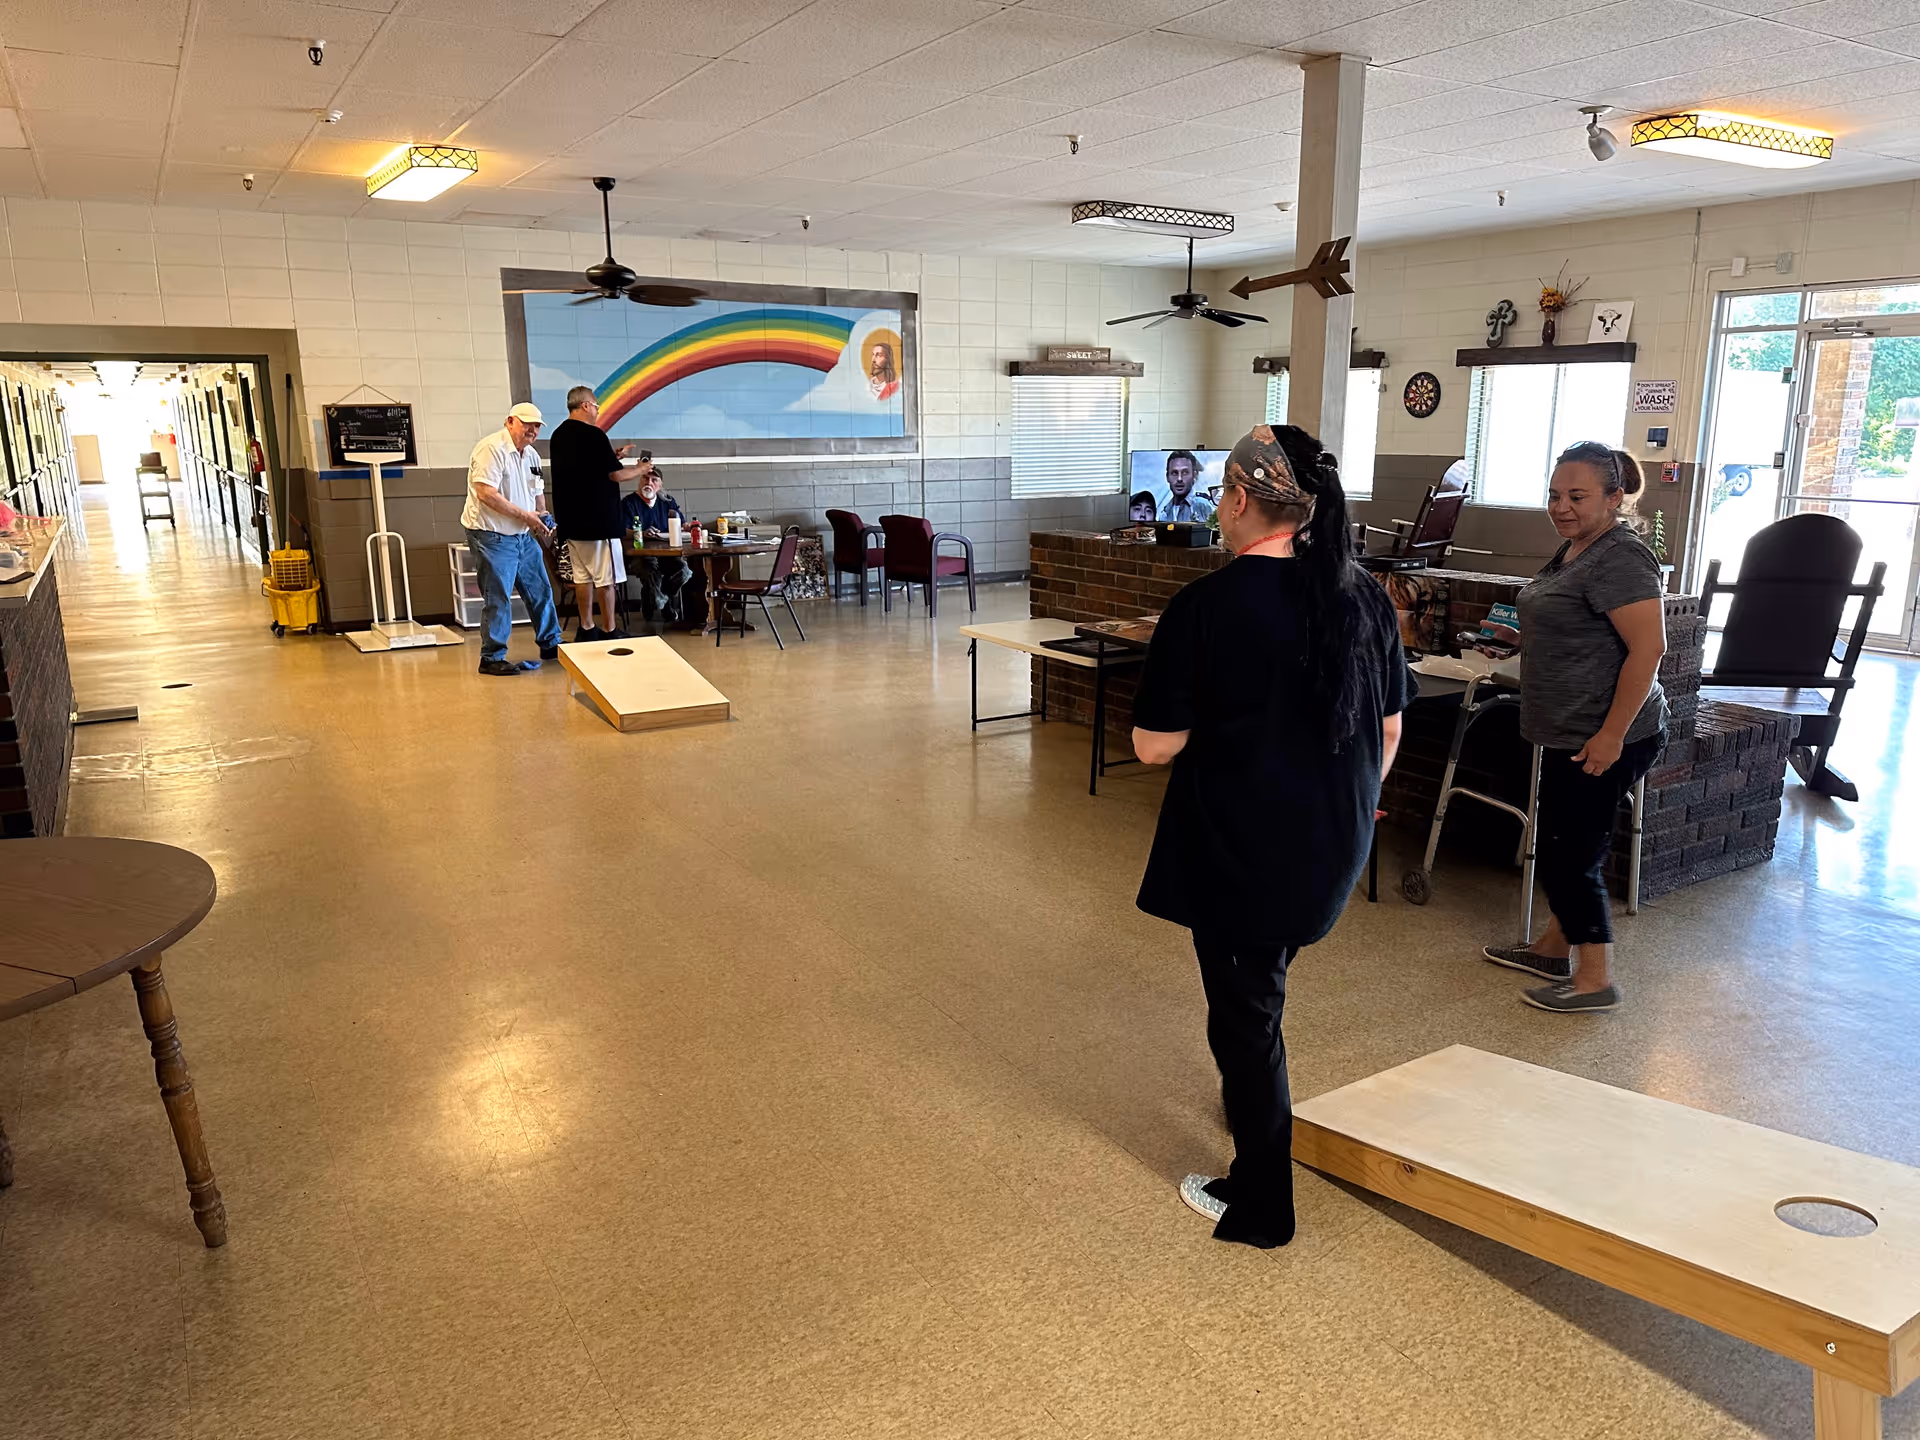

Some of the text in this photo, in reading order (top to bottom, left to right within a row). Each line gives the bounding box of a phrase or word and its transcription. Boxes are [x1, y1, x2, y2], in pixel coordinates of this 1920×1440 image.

[1066, 351, 1092, 359] SWEET
[1640, 395, 1670, 404] WASH
[1492, 608, 1518, 619] Killer W
